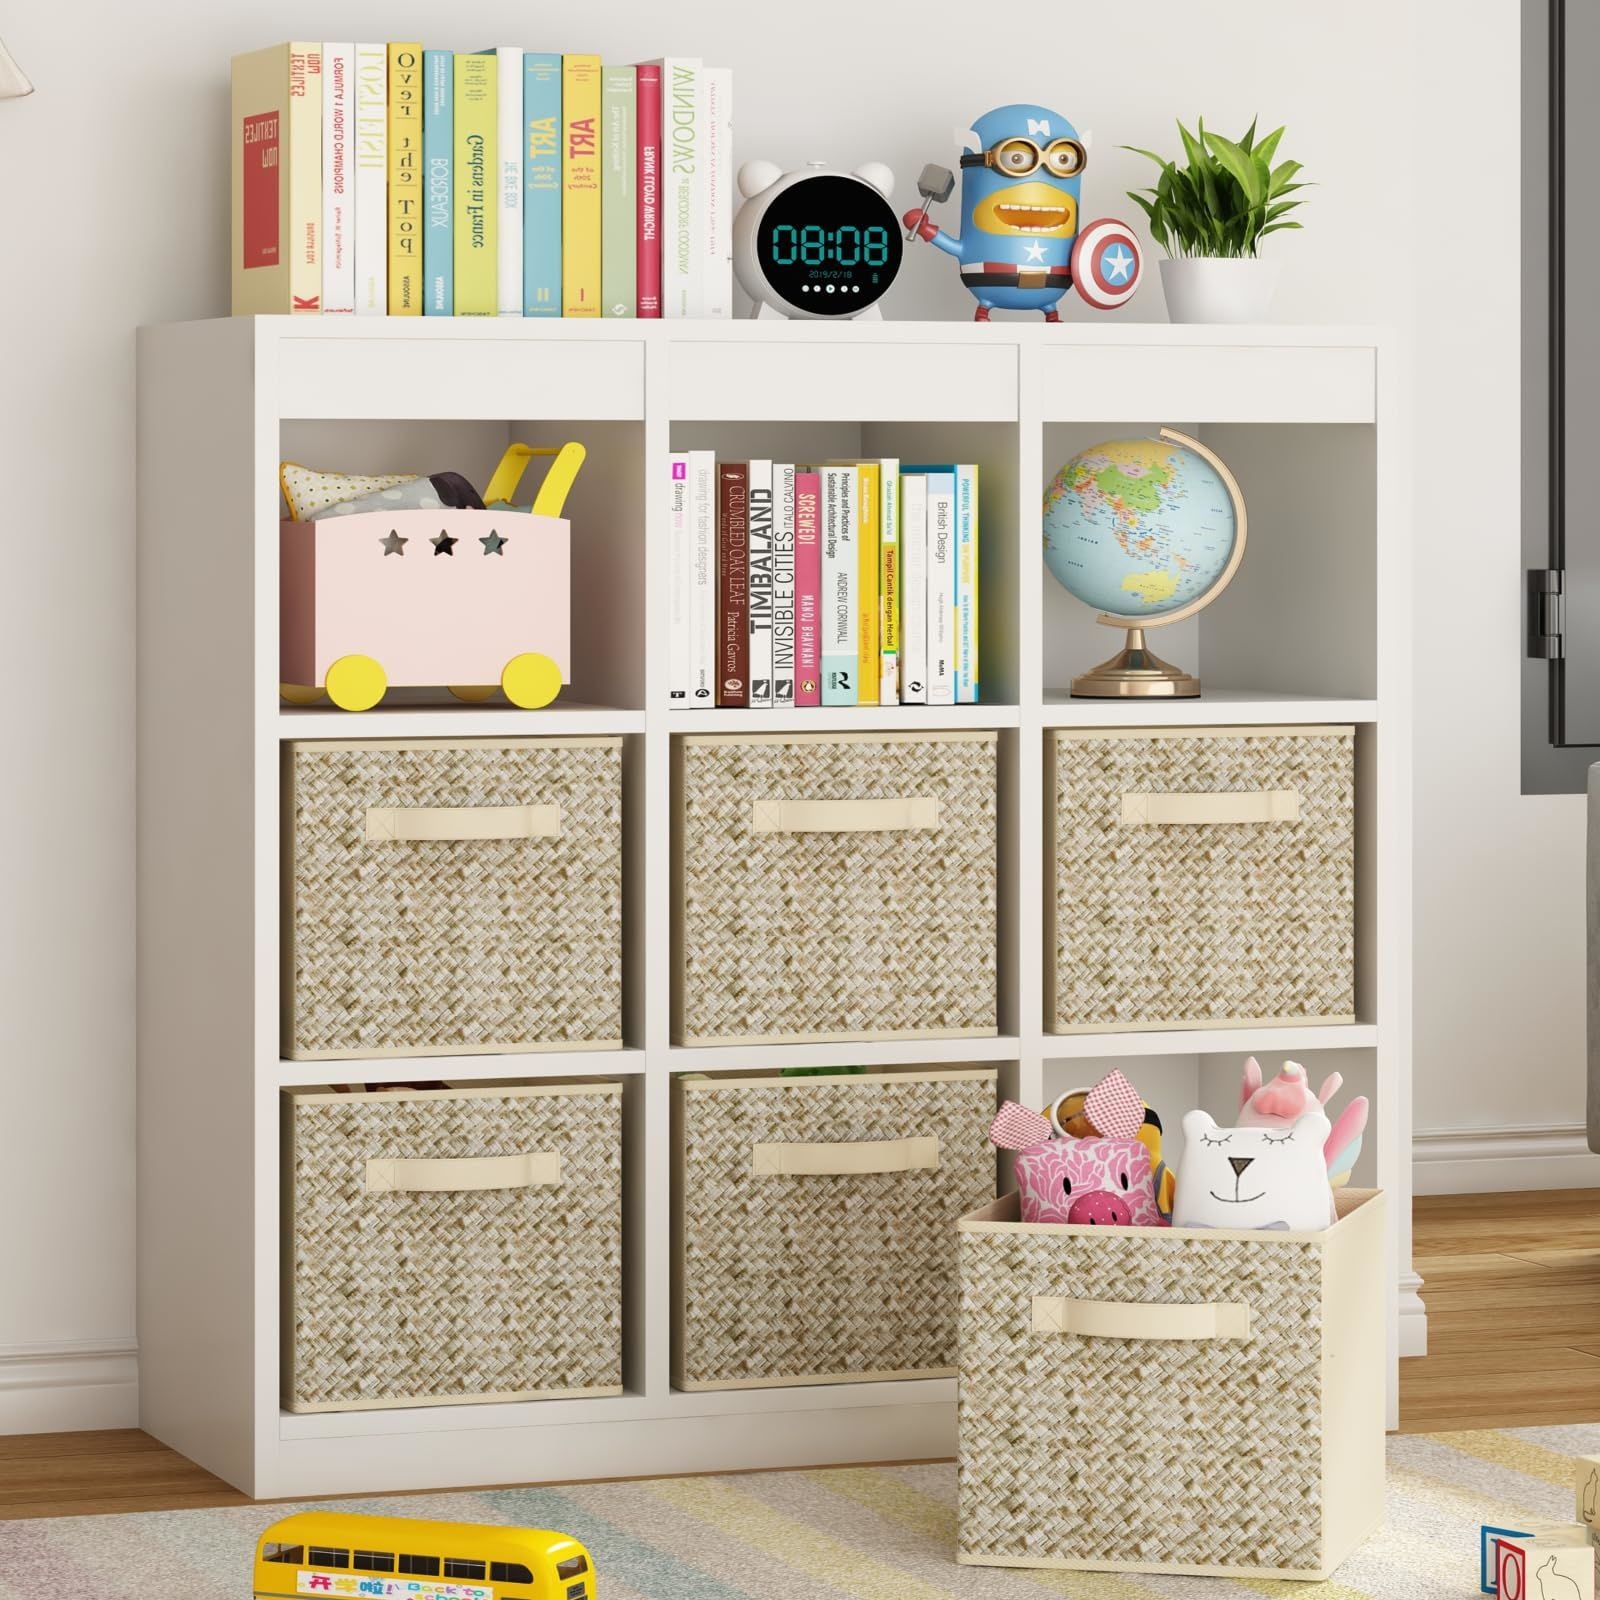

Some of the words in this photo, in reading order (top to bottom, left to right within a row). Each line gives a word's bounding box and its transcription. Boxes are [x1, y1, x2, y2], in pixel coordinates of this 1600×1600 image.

[773, 225, 888, 266] 08:08
[672, 483, 686, 512] drawing
[784, 468, 794, 504] CALVINO
[828, 473, 837, 502] Sustainable
[841, 473, 850, 498] Principles
[962, 478, 970, 510] POWERFUL
[728, 486, 745, 548] CRUMBLED
[784, 506, 794, 529] ITALO
[842, 499, 850, 509] and
[937, 502, 948, 529] British
[828, 504, 837, 538] Architectural
[842, 510, 850, 534] Practices
[962, 512, 970, 542] THINKING
[728, 549, 745, 575] OAK
[750, 488, 772, 634] TIMBALAND
[774, 532, 794, 584] CITIES
[827, 540, 836, 558] Design
[936, 532, 948, 563] Design
[728, 578, 745, 605] LEAF
[838, 572, 848, 602] ANDREW
[727, 612, 740, 641] Patricia
[774, 590, 794, 669] INVISIBLE
[838, 604, 848, 644] CORNWALL
[727, 644, 740, 672] Gavros
